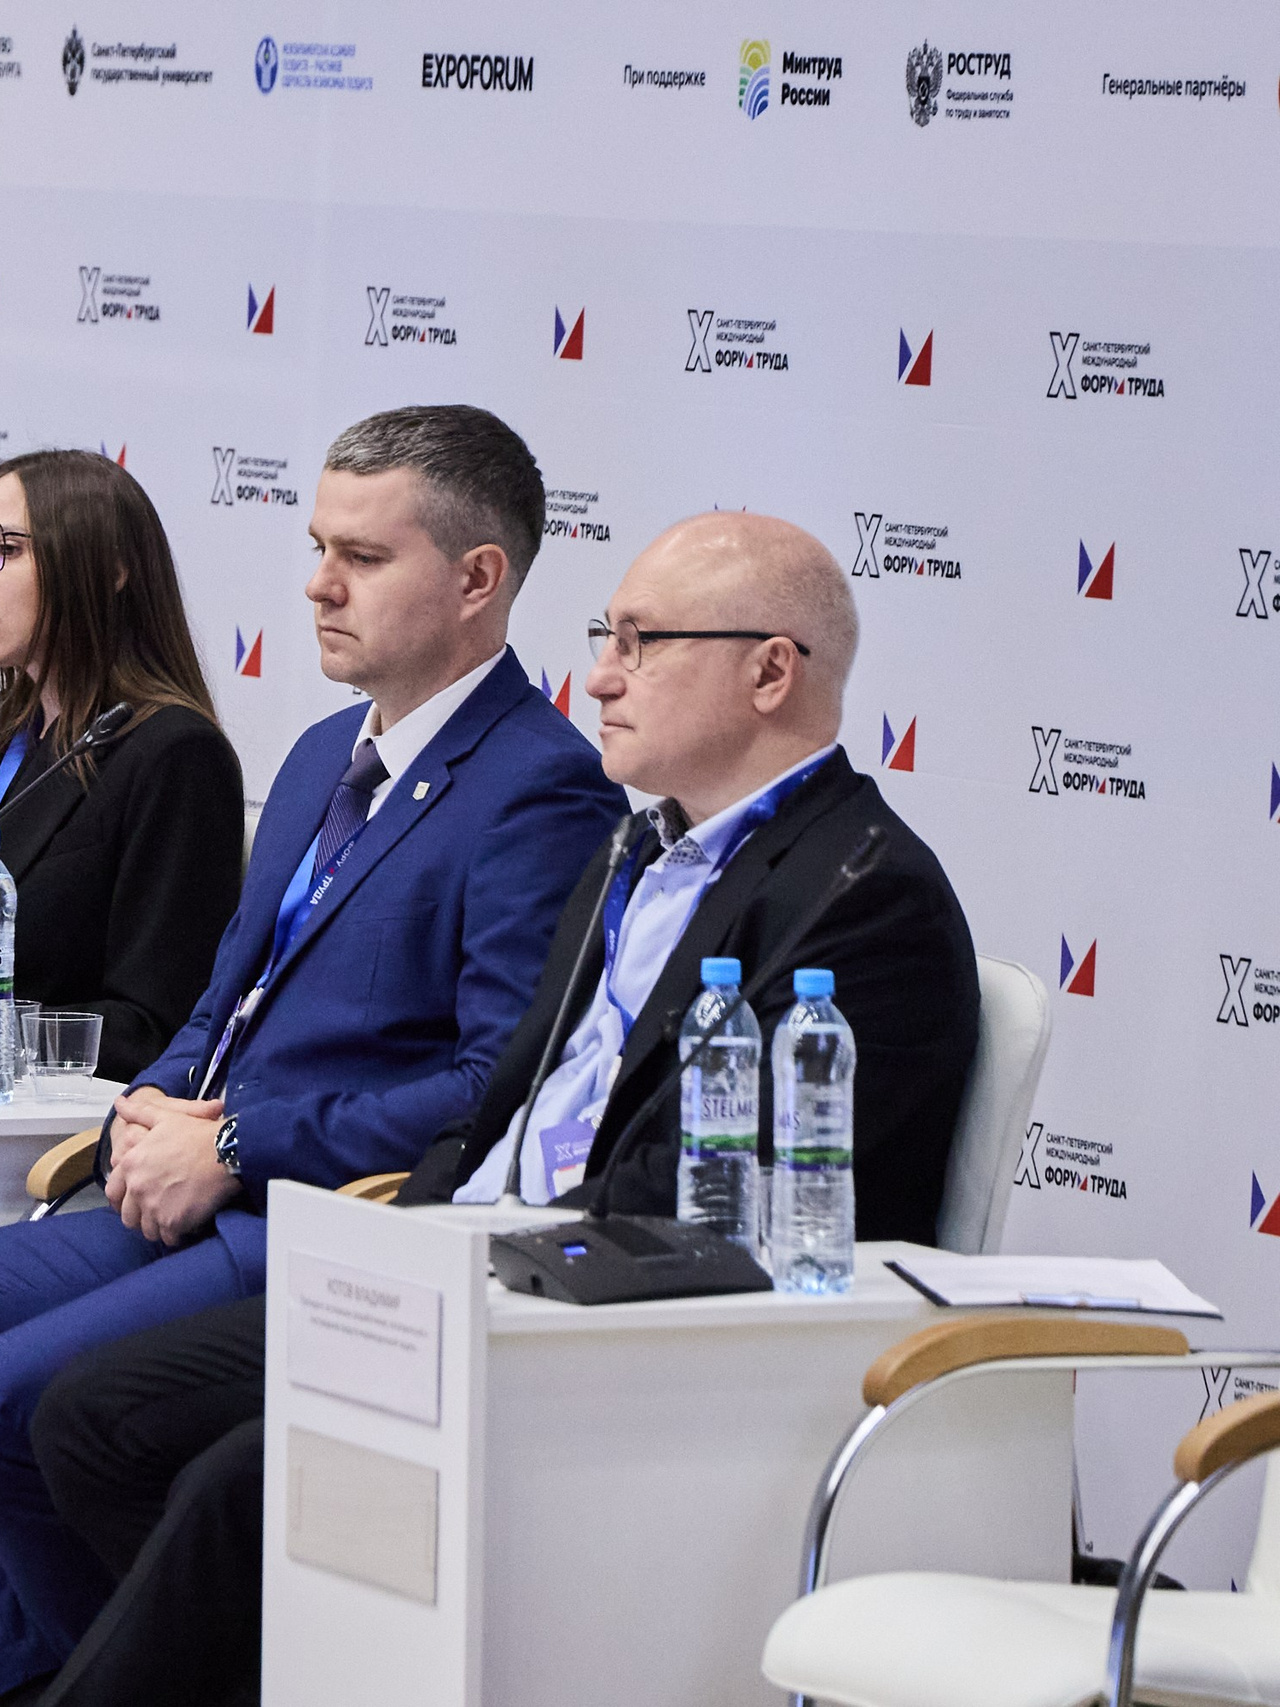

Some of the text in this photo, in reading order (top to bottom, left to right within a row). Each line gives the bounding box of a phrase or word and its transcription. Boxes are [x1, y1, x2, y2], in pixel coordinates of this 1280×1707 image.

[91, 42, 176, 62] Санкт-Петербургский
[91, 66, 212, 86] государственный университет
[422, 54, 533, 90] EXPOFORUM
[782, 52, 842, 80] Минтруд
[947, 53, 1011, 79] РОСТРУД
[624, 65, 706, 91] При поддержке
[1102, 73, 1246, 101] Генеральные партнёры
[781, 83, 830, 106] России
[717, 318, 776, 331] САНКТ-ПЕТЕРБУРГСКИЙ
[428, 327, 457, 345] ТРУДА
[716, 332, 765, 343] МЕЖДУНАРОДНЫЙ
[1082, 341, 1151, 355] САНКТ-ПЕТЕРБУРГСКИЙ
[756, 351, 788, 371] ТРУДА
[1082, 355, 1137, 368] МЕЖДУНАРОДНЫЙ
[1128, 377, 1164, 397] ТРУДА
[580, 523, 610, 541] ТРУДА
[885, 523, 949, 538] САНКТ-ПЕТЕРБУРГСКИЙ
[884, 537, 936, 550] МЕЖДУНАРОДНЫЙ
[927, 559, 961, 579] ТРУДА
[1236, 548, 1271, 619] X
[1064, 738, 1131, 756] САНКТ-ПЕТЕРБУРГСКИЙ
[1064, 753, 1118, 768] МЕЖДУНАРОДНЫЙ
[1109, 777, 1145, 799] ТРУДА
[310, 875, 333, 905] ТРУДА
[1216, 954, 1251, 1027] X
[1253, 1002, 1280, 1023] ФОР
[1046, 1133, 1113, 1155] САНКТ-ПЕТЕРБУРГСКИЙ
[1046, 1148, 1100, 1166] МЕЖДУНАРОДНЫЙ
[1090, 1175, 1127, 1200] ТРУДА
